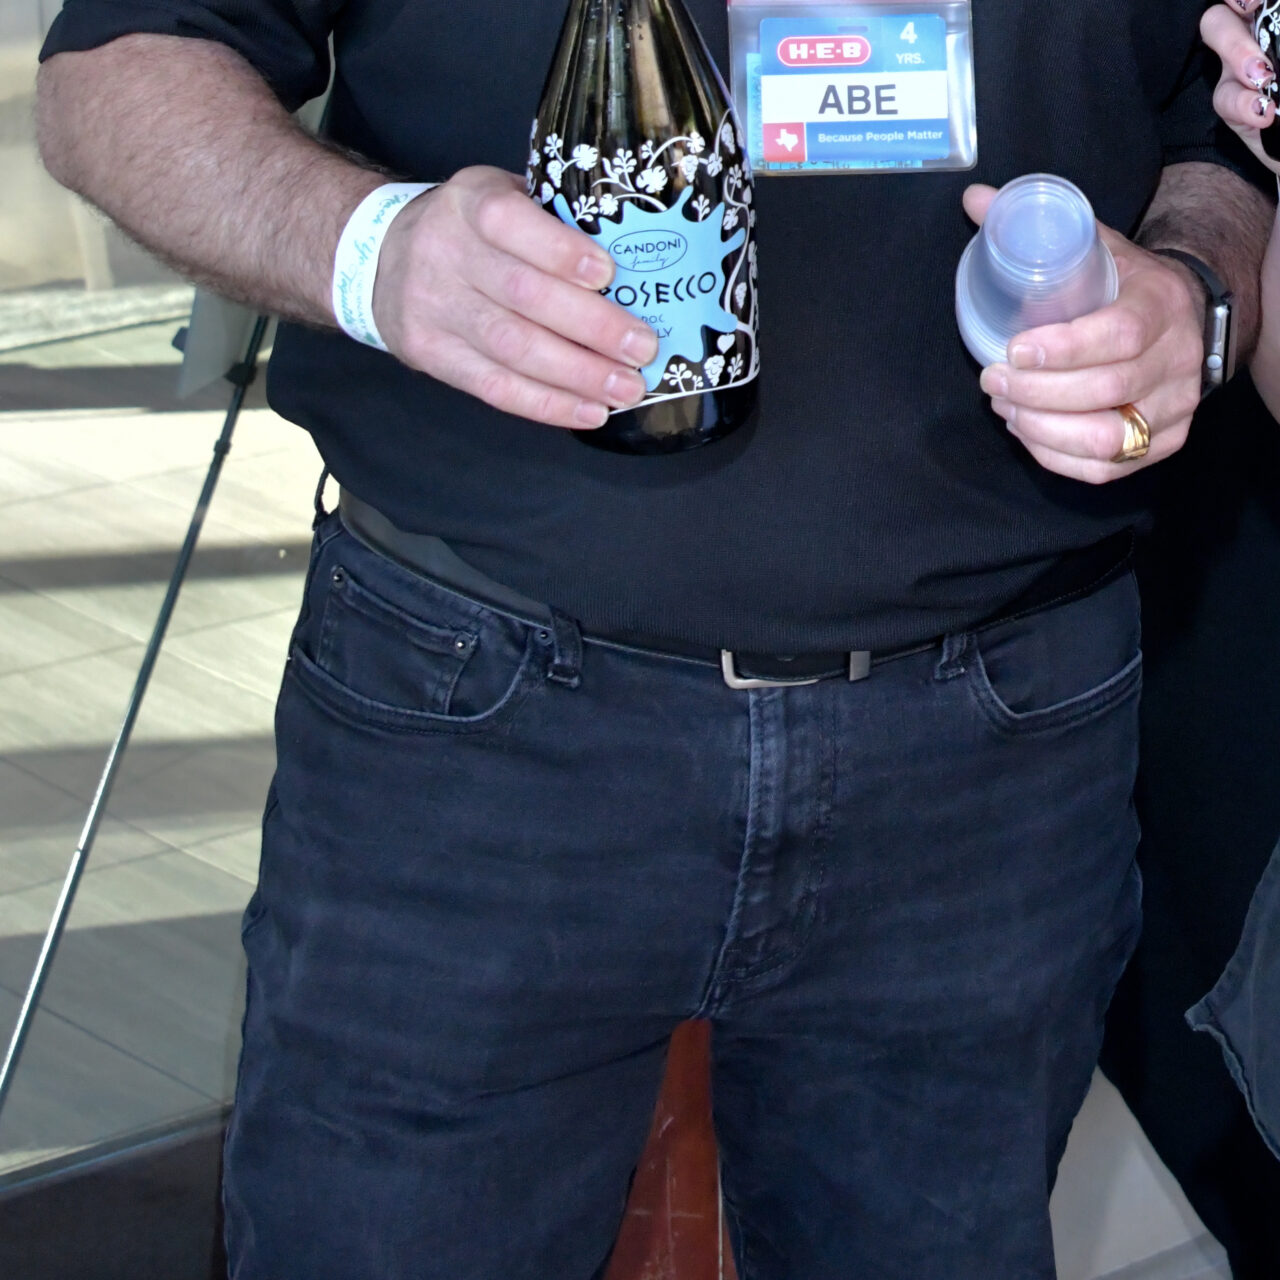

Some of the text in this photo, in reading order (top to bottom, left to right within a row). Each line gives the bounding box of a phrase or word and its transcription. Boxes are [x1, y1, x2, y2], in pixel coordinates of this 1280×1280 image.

[899, 21, 918, 44] 4
[788, 42, 862, 60] H-E-B
[895, 52, 925, 65] YRS.
[818, 83, 899, 116] ABE
[817, 129, 943, 144] Because People Matter
[613, 238, 681, 255] CANDONI
[599, 271, 717, 308] OSECCO
